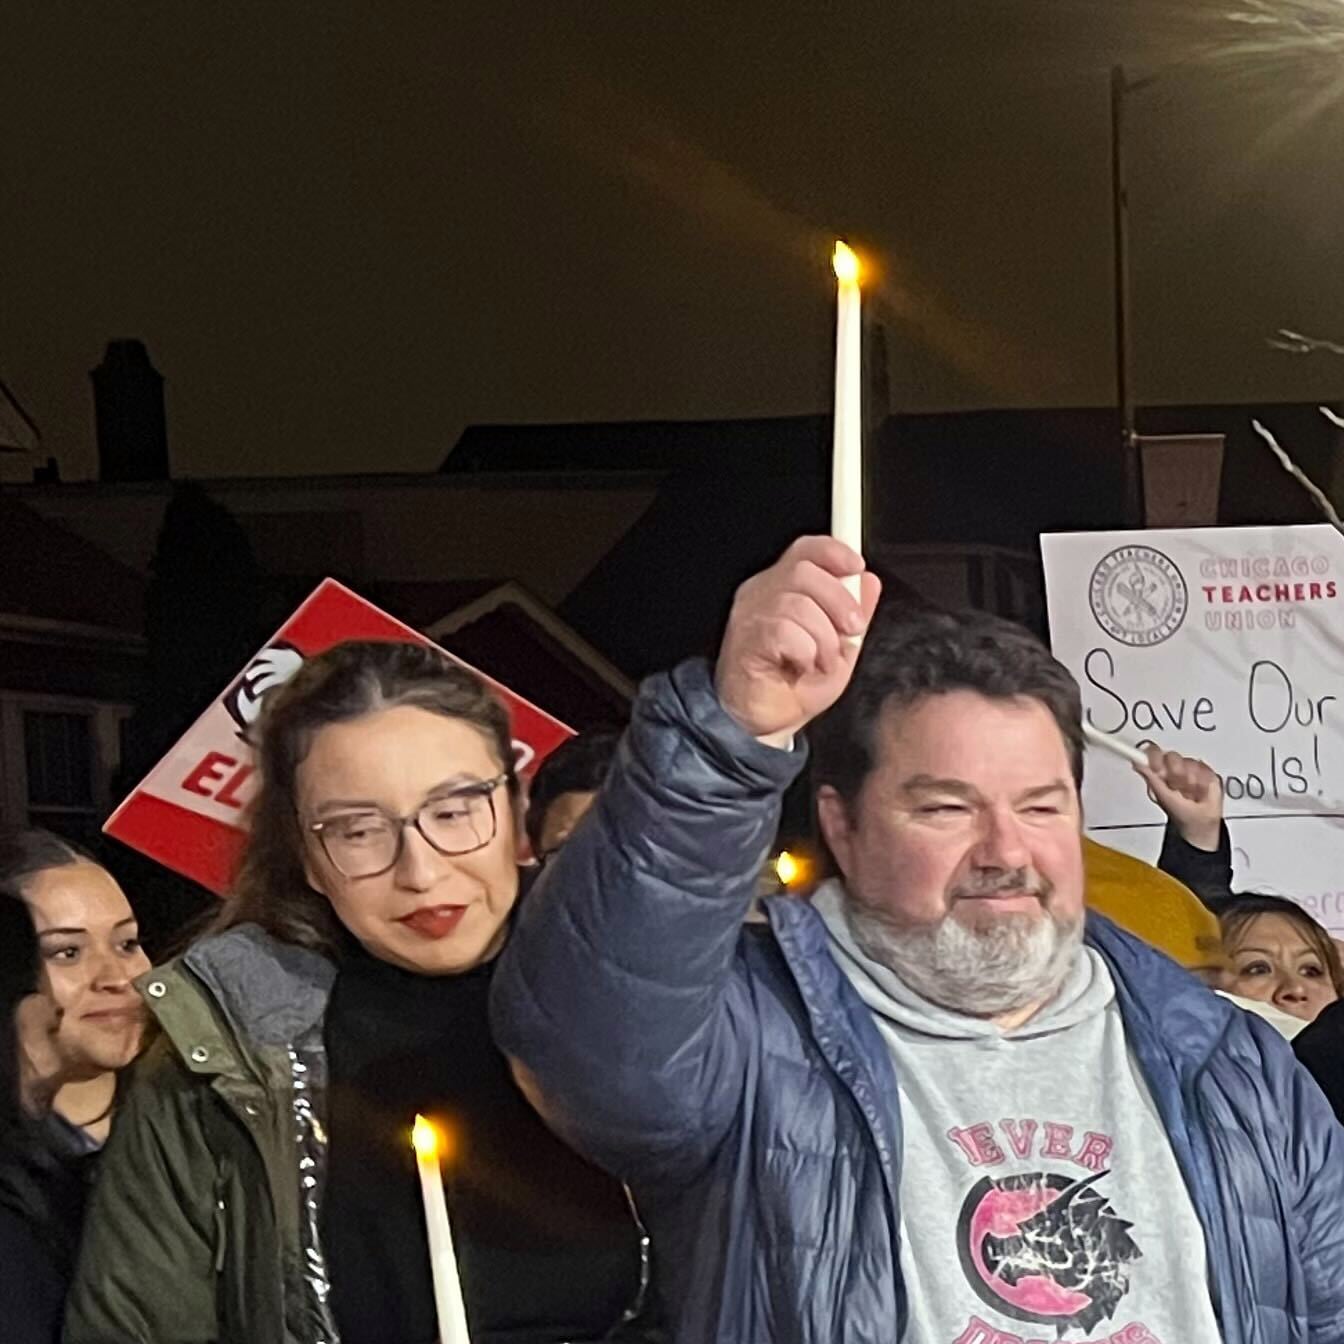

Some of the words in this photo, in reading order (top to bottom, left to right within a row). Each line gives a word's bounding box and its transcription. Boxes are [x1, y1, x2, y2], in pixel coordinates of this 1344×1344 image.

[1200, 555, 1329, 579] CHICAGO
[1202, 581, 1336, 603] TEACHERS
[1204, 608, 1296, 631] UNION
[1085, 648, 1216, 734] Save
[1249, 660, 1336, 733] Our
[181, 751, 255, 810] EL
[947, 1118, 1114, 1171] EVER
